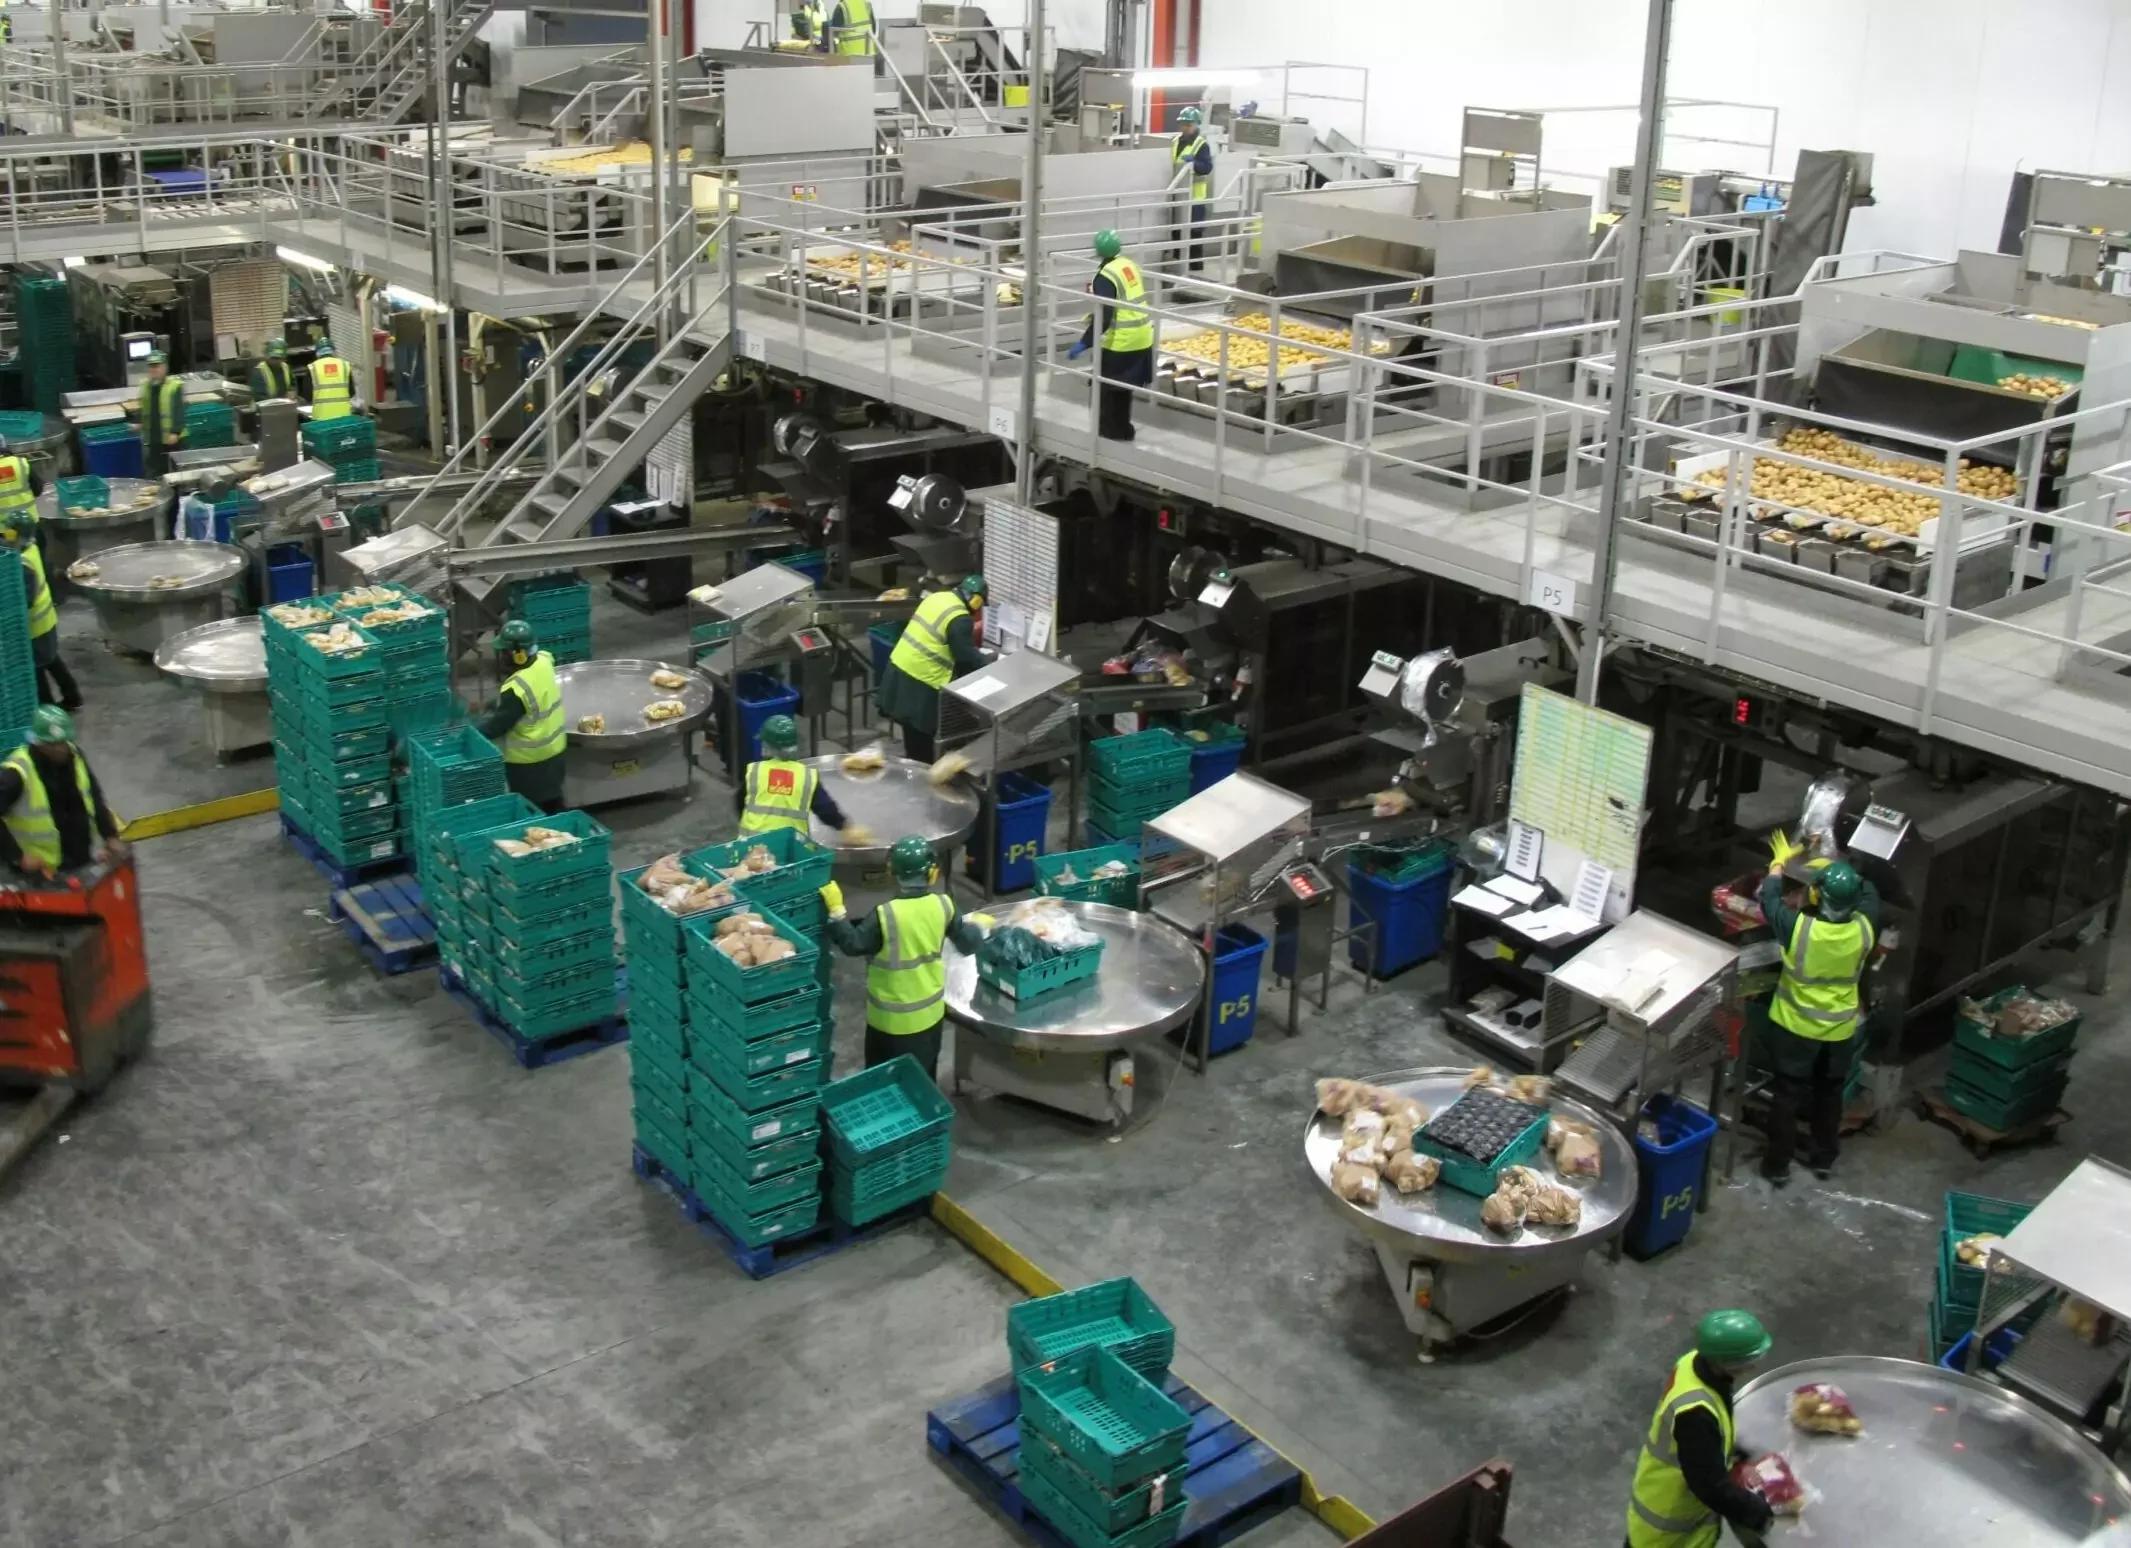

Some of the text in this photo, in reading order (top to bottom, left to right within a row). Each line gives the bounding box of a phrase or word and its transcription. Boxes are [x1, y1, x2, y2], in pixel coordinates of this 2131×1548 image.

[1543, 586, 1563, 606] P5
[1009, 840, 1037, 864] P5
[1220, 995, 1250, 1024] P5
[1661, 1186, 1692, 1219] P5
